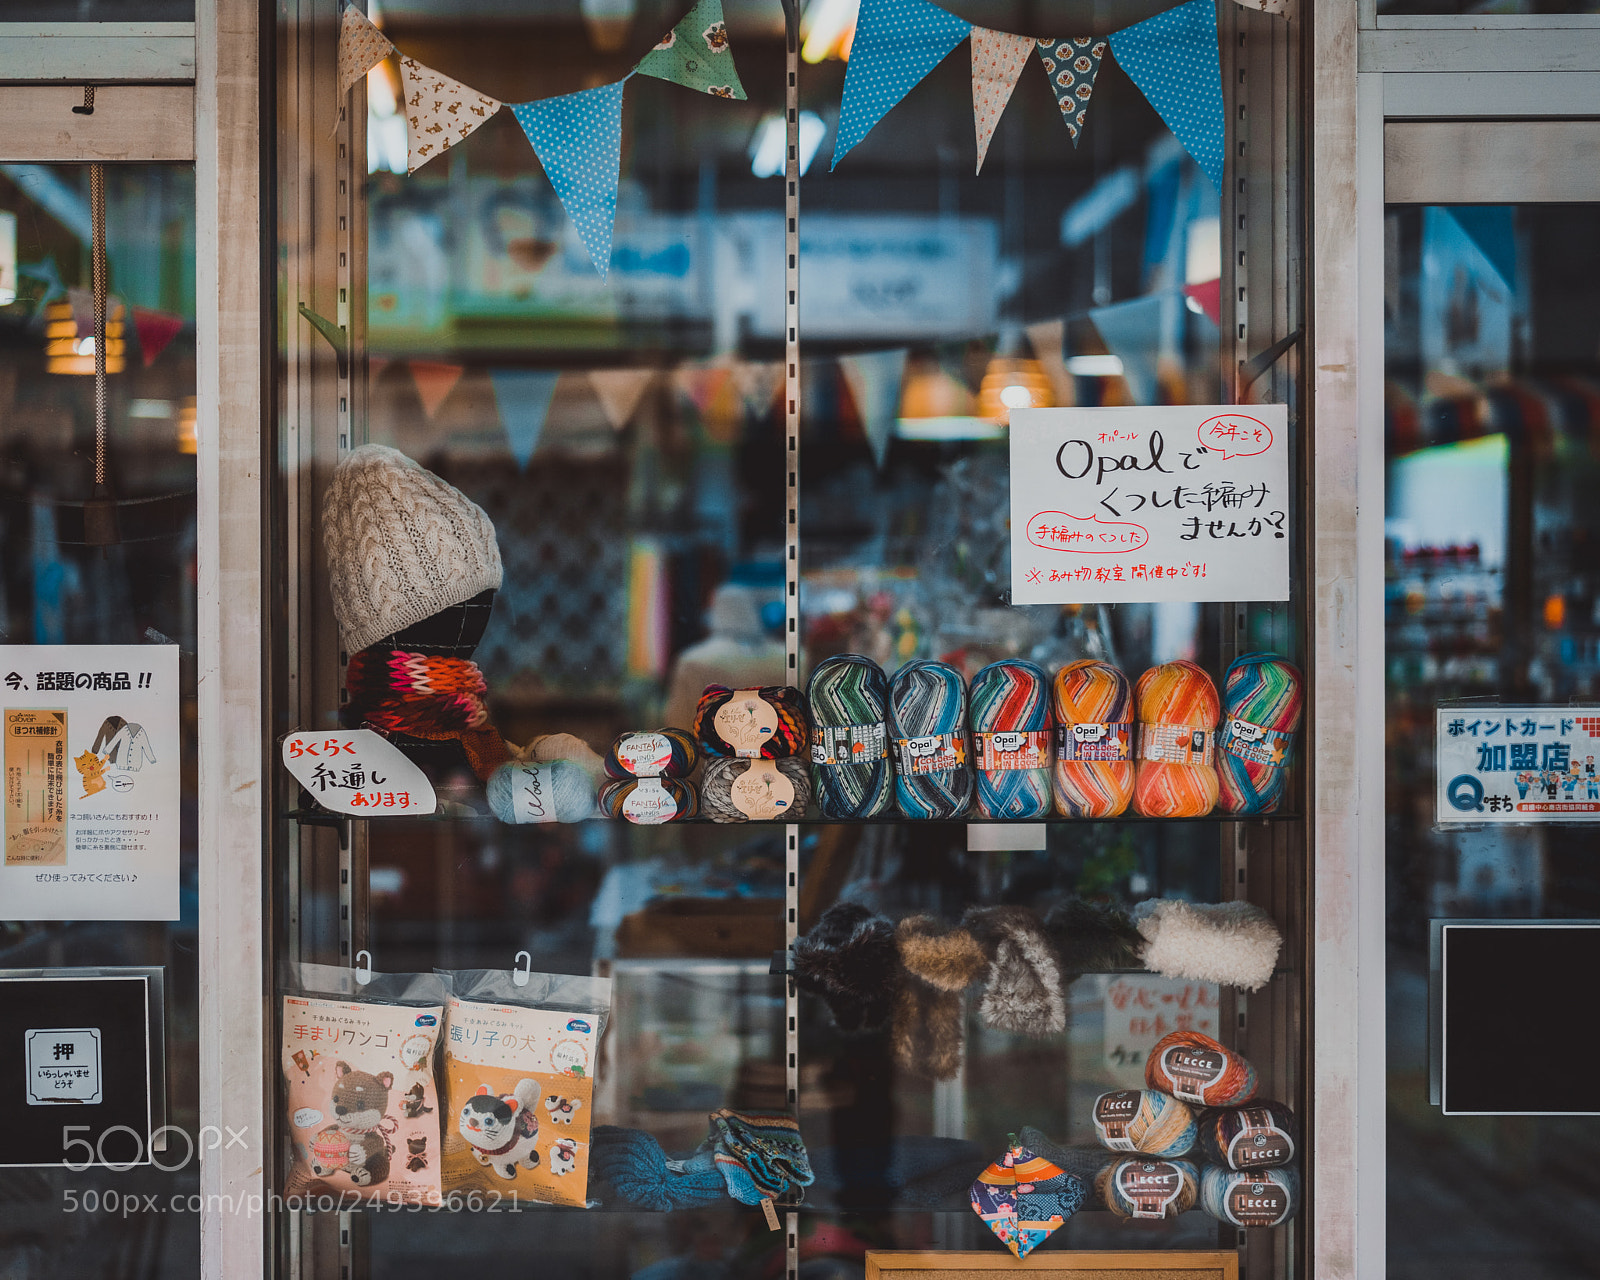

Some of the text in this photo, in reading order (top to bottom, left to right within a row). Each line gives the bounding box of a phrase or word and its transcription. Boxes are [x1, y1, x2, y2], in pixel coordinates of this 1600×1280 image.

[1098, 429, 1139, 444] オパール
[1209, 420, 1263, 445] 今年こそ
[1100, 481, 1271, 517] くつした編み
[1180, 511, 1286, 540] ませんか?
[1035, 524, 1142, 544] 手編みのくつした
[14, 726, 58, 735] ほつれ補修針
[1076, 726, 1098, 739] Opal
[1234, 721, 1256, 735] Opal
[1448, 718, 1574, 737] ポイントカード
[626, 737, 664, 752] FANTASIA
[910, 739, 932, 753] Opal
[995, 734, 1017, 748] Opal
[289, 739, 357, 759] らくらく
[1476, 742, 1571, 772] 加盟店
[311, 763, 387, 791] 糸通し
[293, 1024, 389, 1048] 手まりワンコ
[449, 1024, 536, 1053] 張り子の犬
[53, 1043, 75, 1060] 押
[1174, 1053, 1213, 1069] LECCE
[38, 1069, 90, 1079] いらっしゃいませ
[54, 1079, 74, 1089] どうぞ
[1104, 1100, 1133, 1111] LECCE
[1242, 1149, 1280, 1161] LECCE
[1239, 1196, 1277, 1208] LECCE
